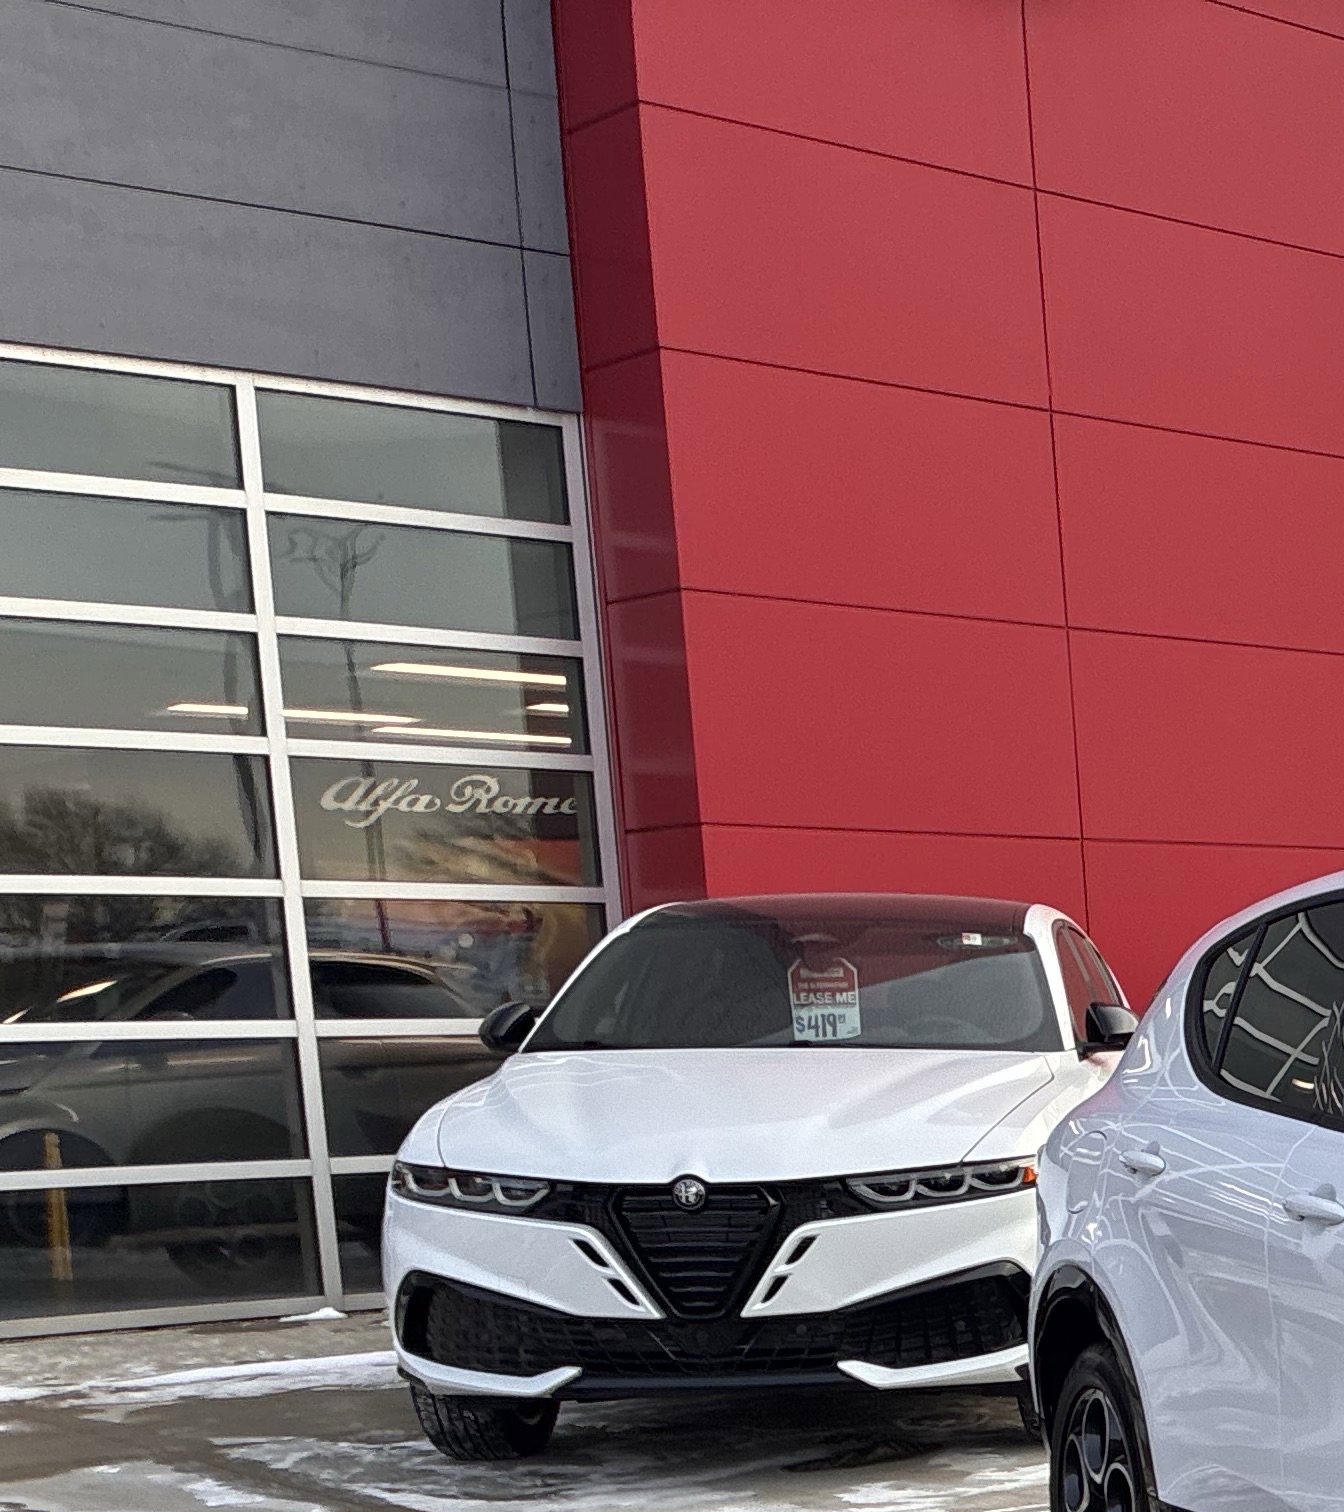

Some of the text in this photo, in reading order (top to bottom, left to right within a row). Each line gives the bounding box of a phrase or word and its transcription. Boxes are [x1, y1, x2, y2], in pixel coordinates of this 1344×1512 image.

[320, 774, 578, 828] Alfa Rome
[793, 991, 857, 1005] LEASE ME
